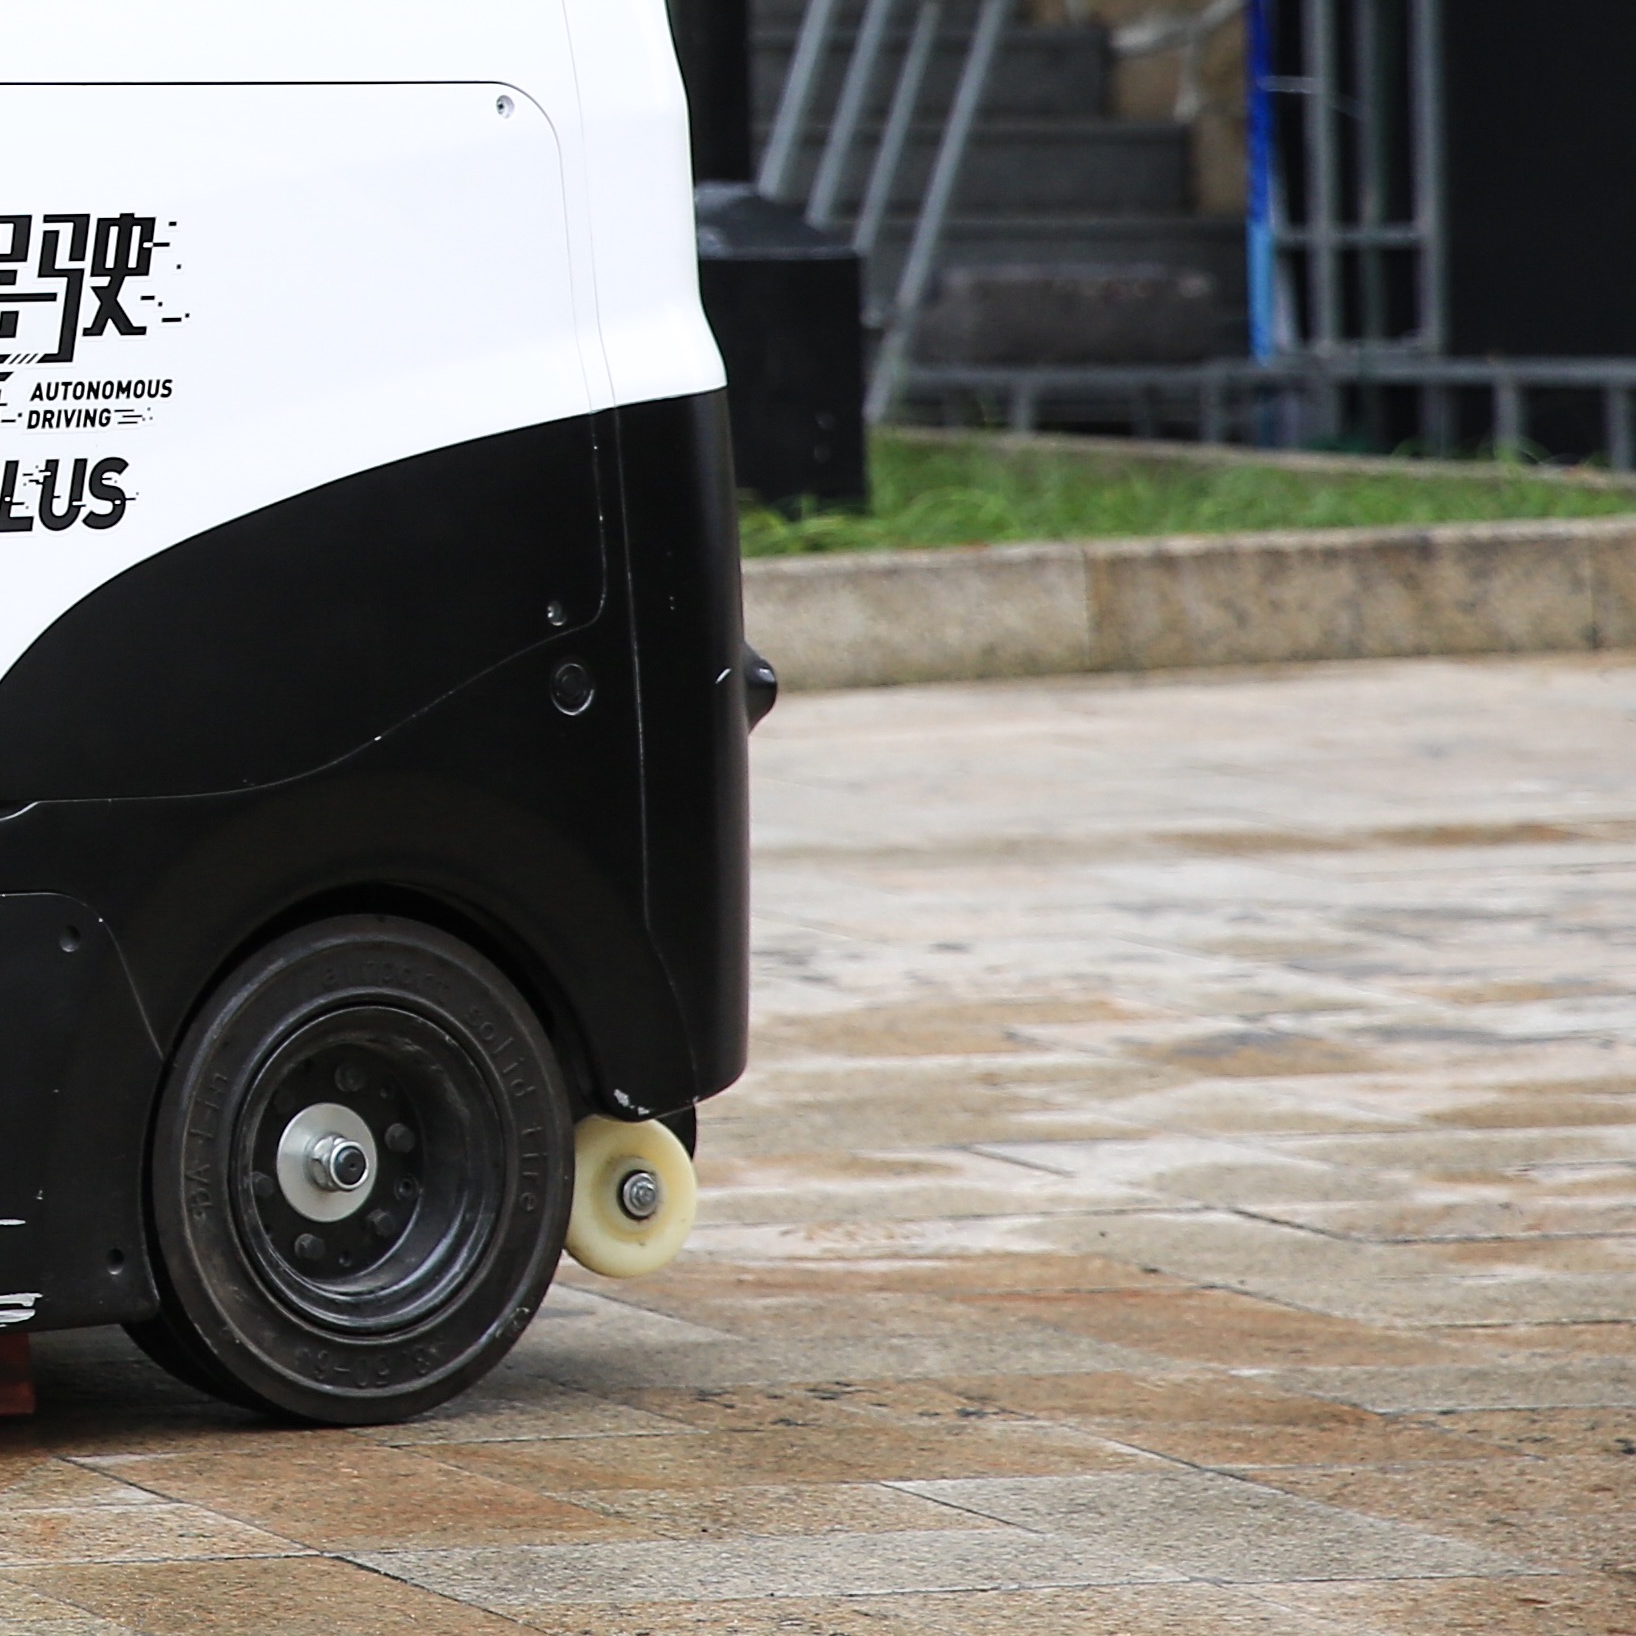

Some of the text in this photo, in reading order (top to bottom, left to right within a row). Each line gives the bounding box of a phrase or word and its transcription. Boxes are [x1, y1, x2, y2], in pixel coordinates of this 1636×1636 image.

[29, 378, 174, 403] AUTONOMOUS
[26, 408, 113, 431] DRIVING
[467, 1005, 537, 1097] solid
[519, 1124, 549, 1213] tire
